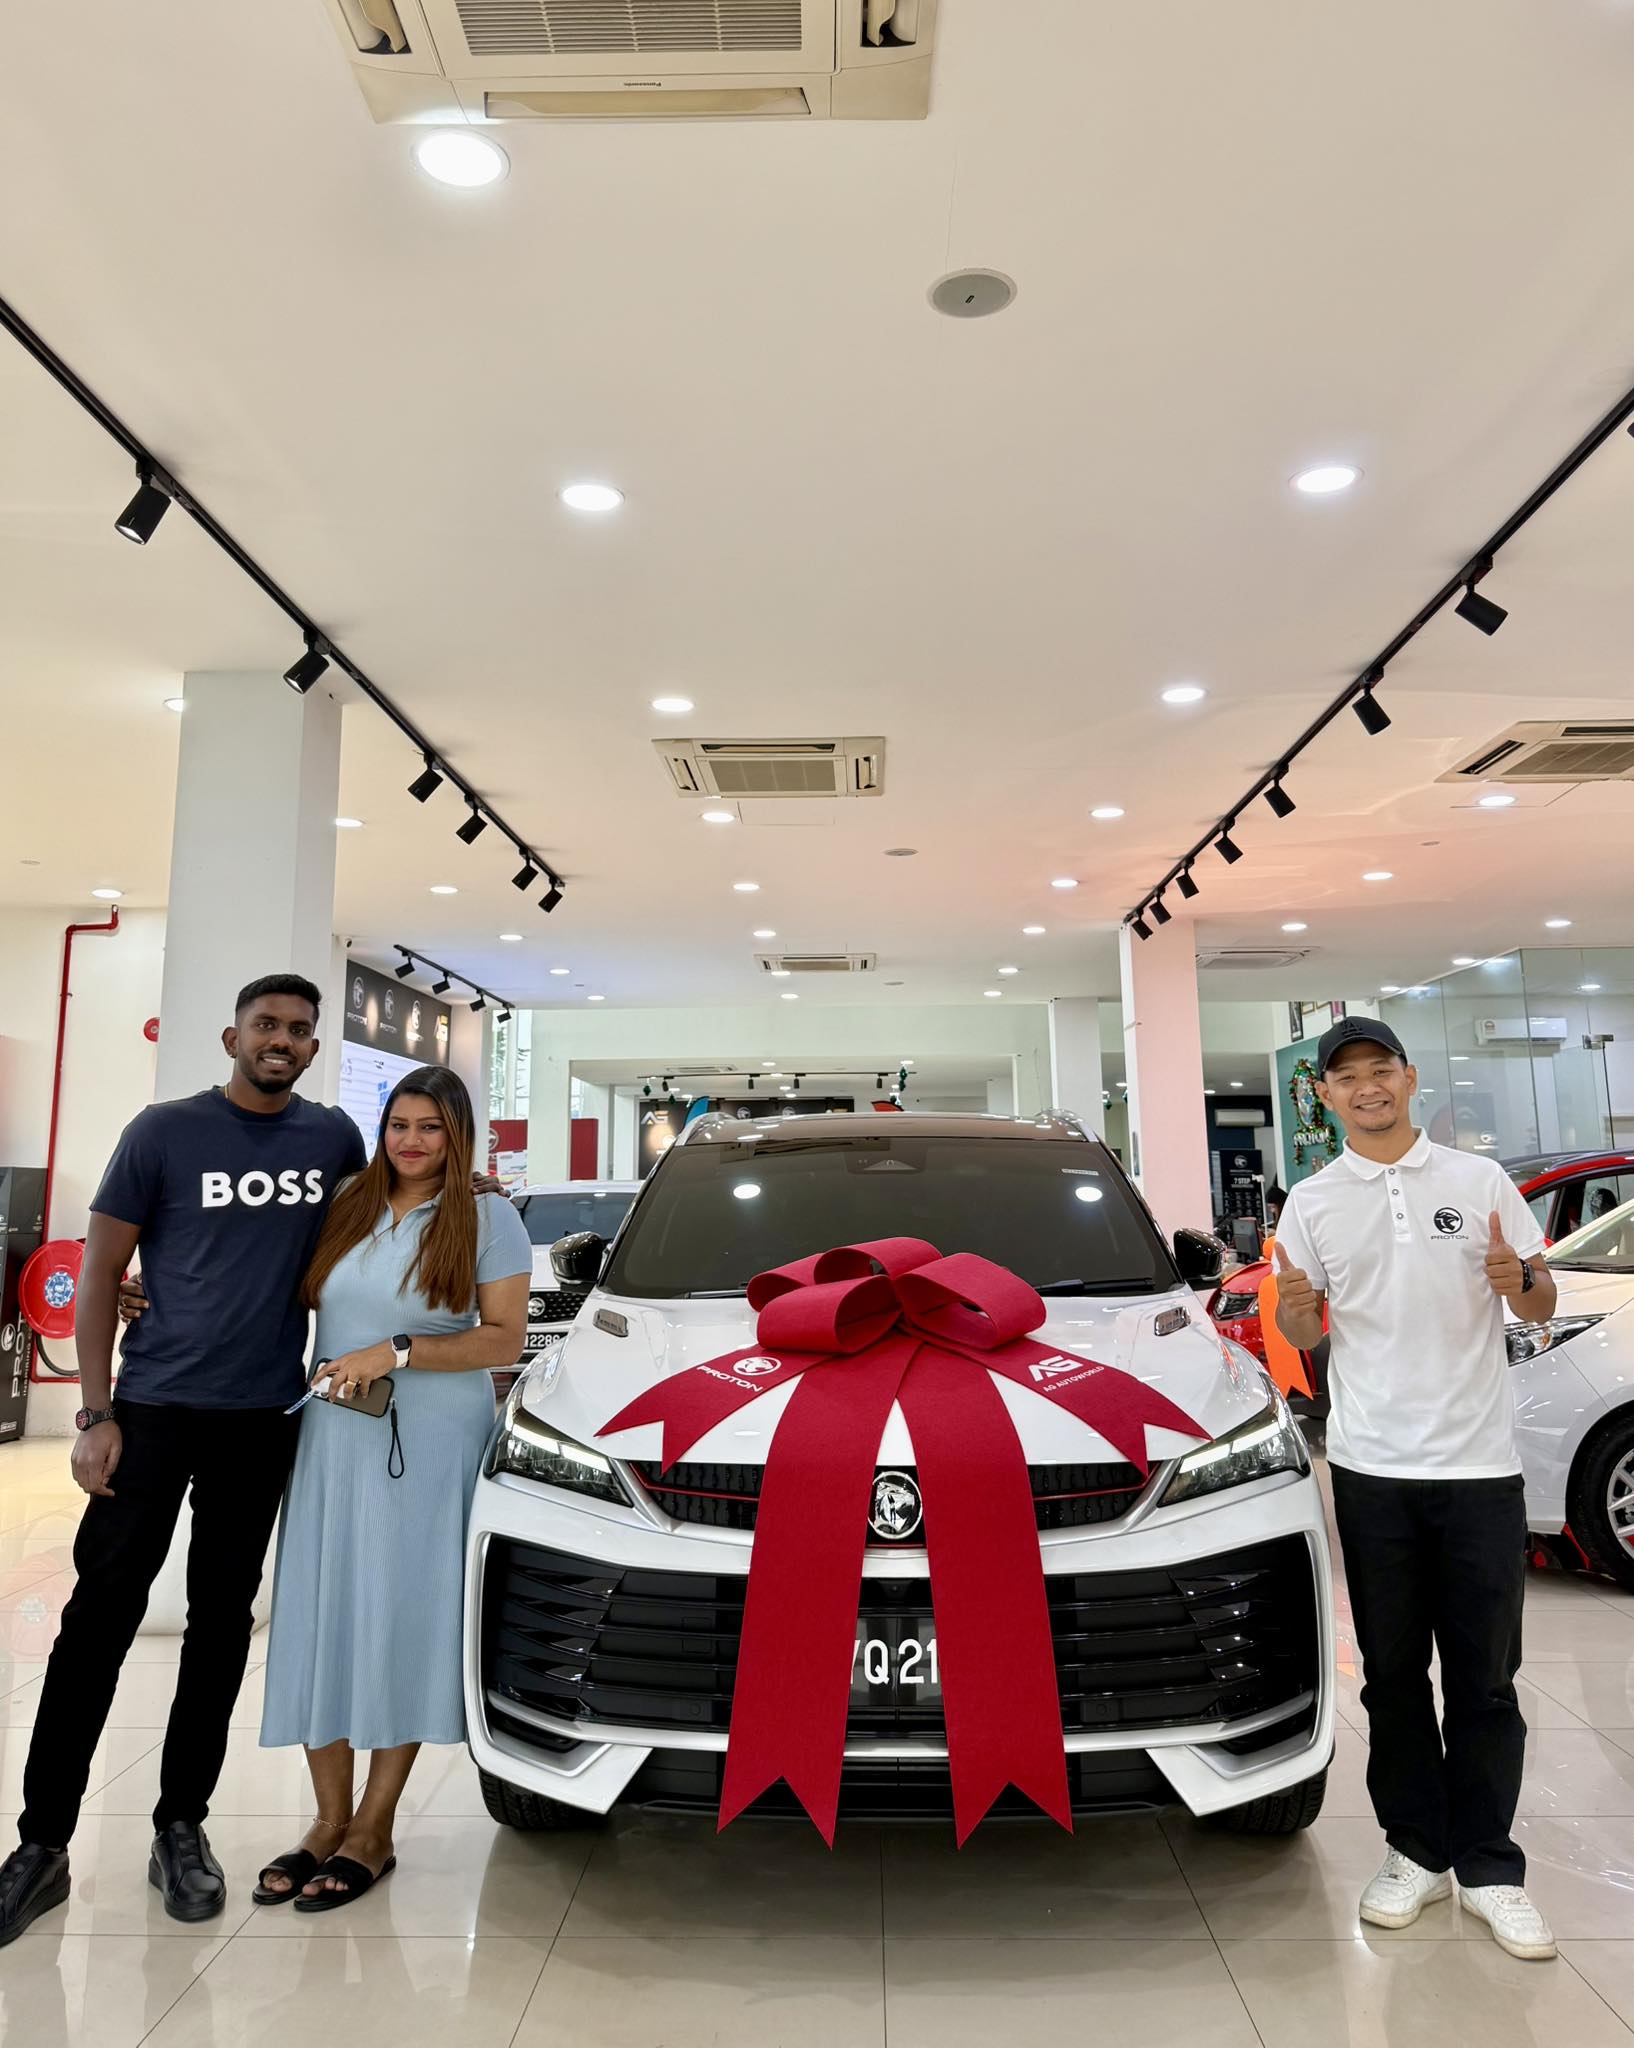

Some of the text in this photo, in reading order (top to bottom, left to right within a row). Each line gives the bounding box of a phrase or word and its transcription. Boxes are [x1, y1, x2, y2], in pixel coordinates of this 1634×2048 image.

[202, 1168, 324, 1208] BOSS
[696, 1364, 764, 1392] PROTON
[1043, 1365, 1105, 1393] AG AUTOWORLD
